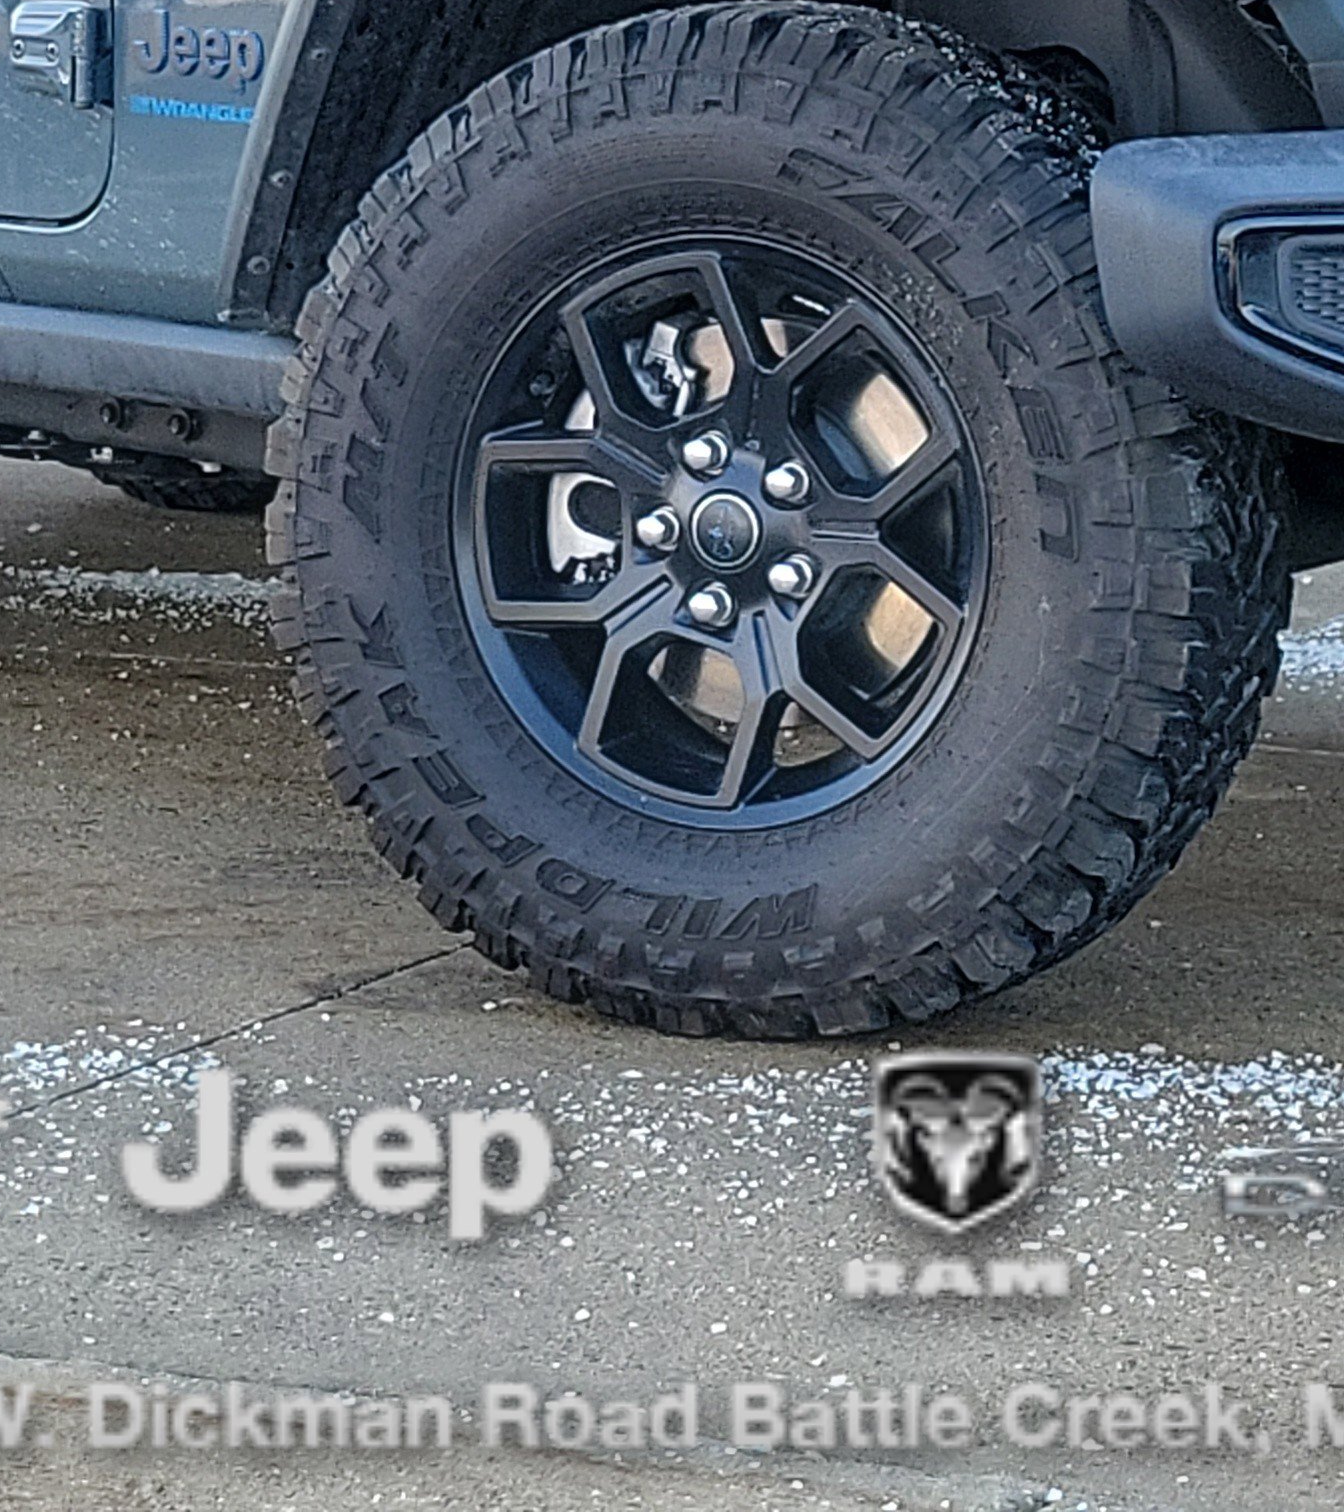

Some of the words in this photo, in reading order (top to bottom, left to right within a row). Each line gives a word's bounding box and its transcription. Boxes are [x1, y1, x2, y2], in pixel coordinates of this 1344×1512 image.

[132, 8, 266, 97] Jeep
[153, 95, 257, 122] WRANGLE
[345, 594, 818, 941] WILDPEAK
